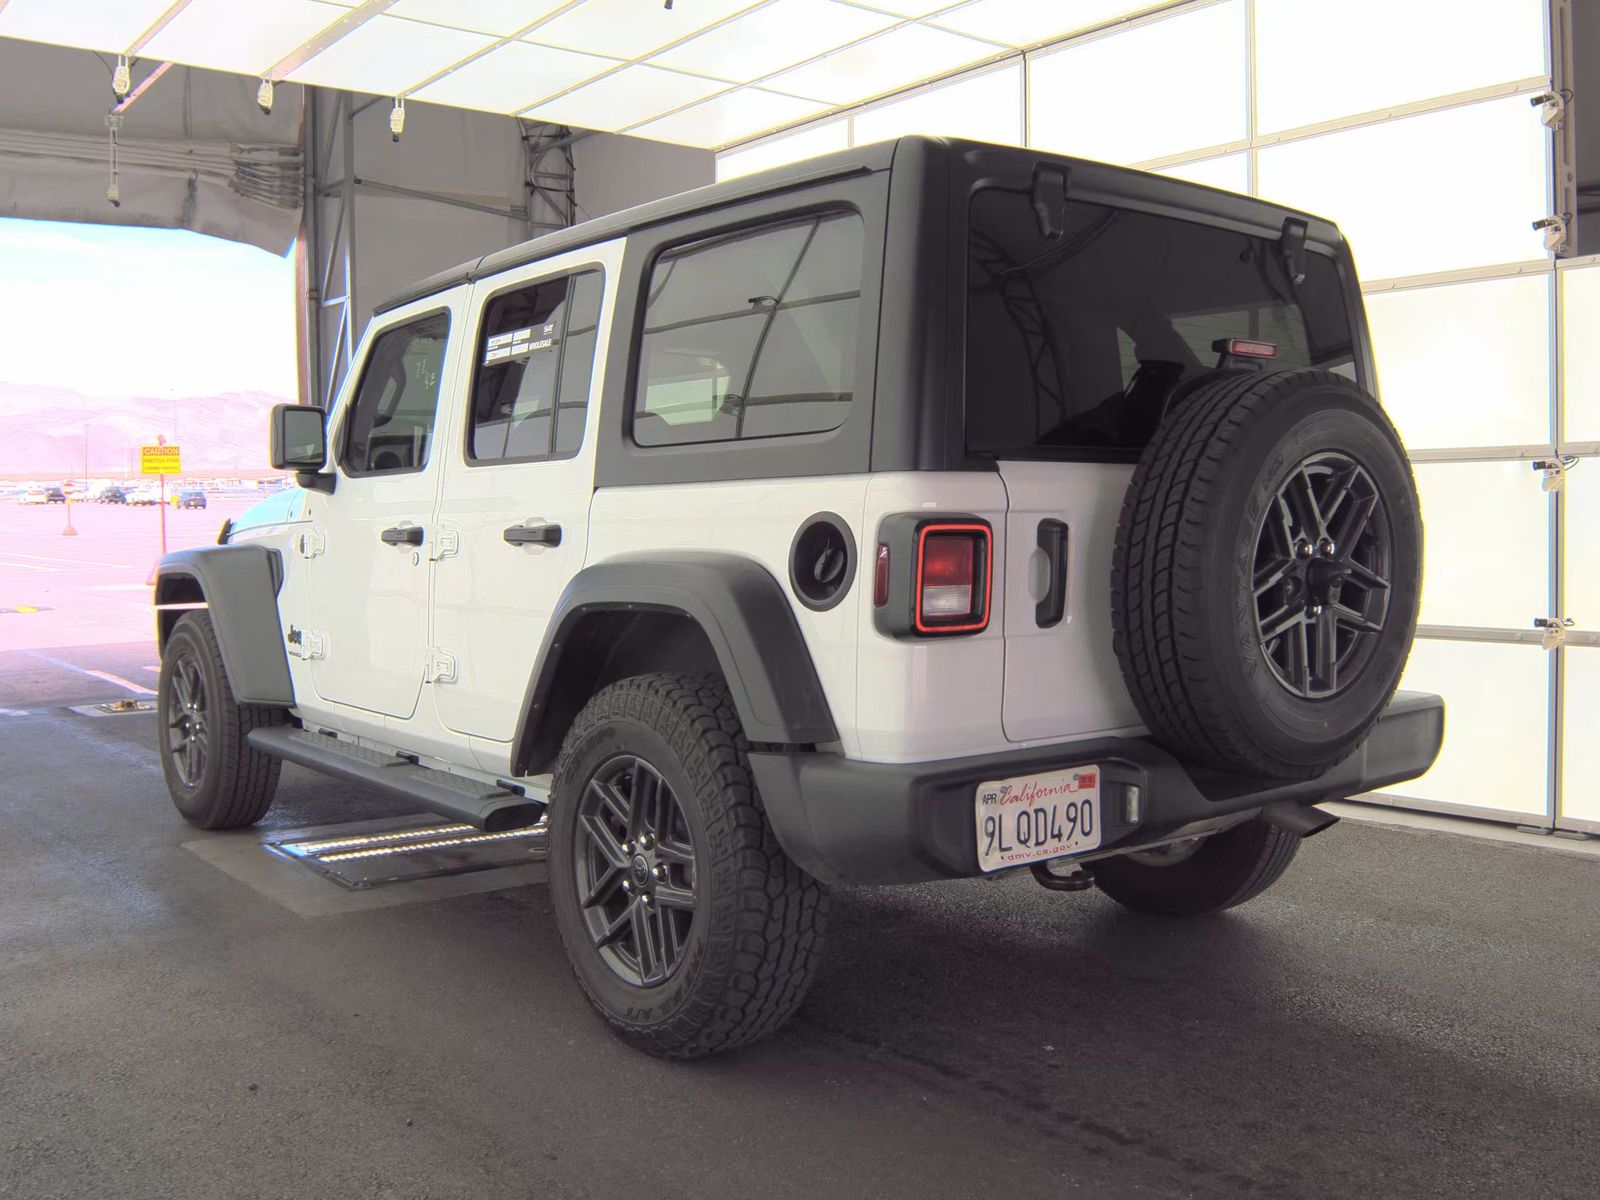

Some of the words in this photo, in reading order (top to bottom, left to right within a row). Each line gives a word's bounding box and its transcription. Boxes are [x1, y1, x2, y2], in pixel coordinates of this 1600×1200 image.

[982, 793, 997, 805] APR
[999, 782, 1078, 807] California
[984, 799, 1093, 857] 9LQD490
[1007, 843, 1072, 861] dmv.ca.gov
